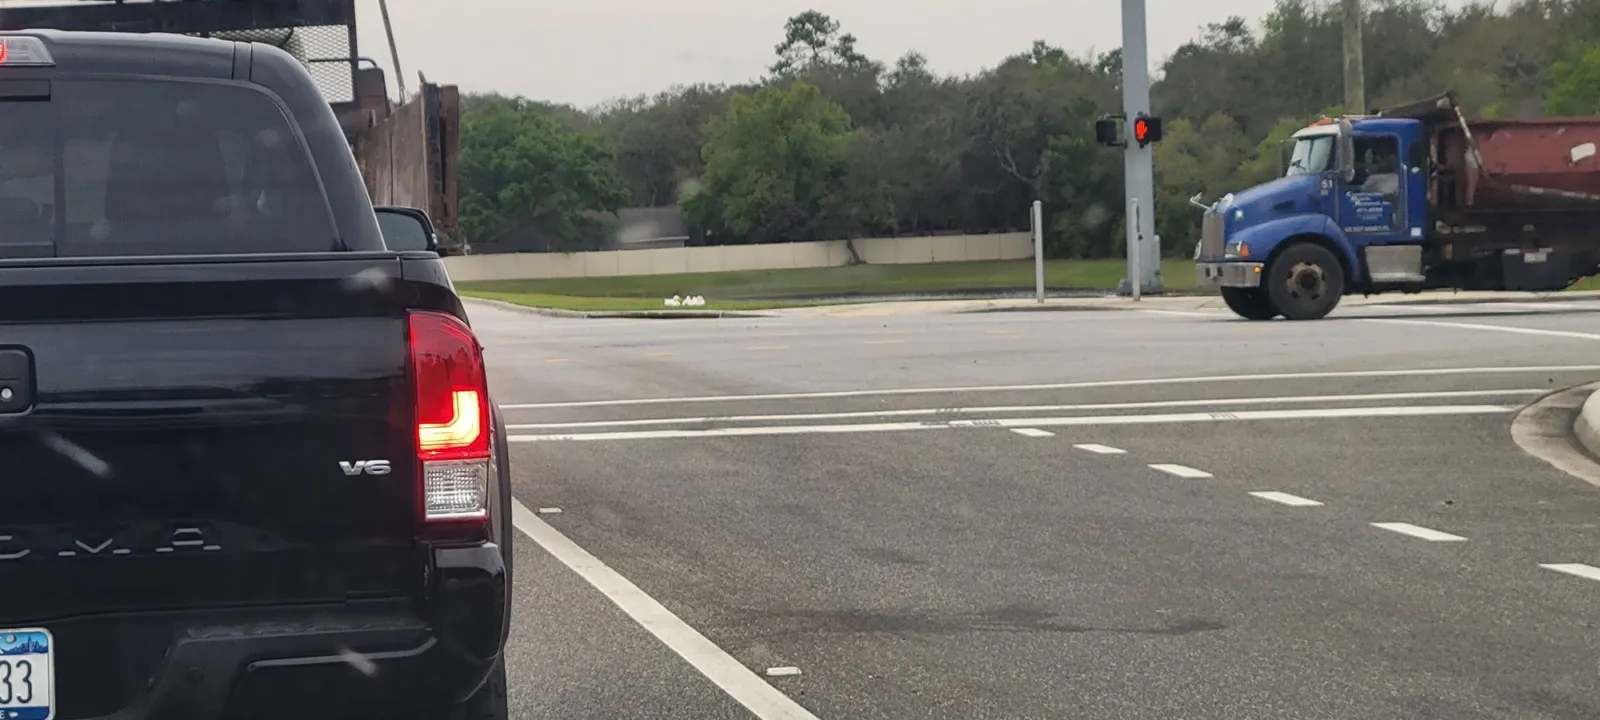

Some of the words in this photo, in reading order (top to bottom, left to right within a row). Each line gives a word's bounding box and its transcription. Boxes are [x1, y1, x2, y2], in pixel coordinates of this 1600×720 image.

[1321, 179, 1333, 189] 51
[339, 460, 391, 475] V6
[0, 660, 33, 704] 33
